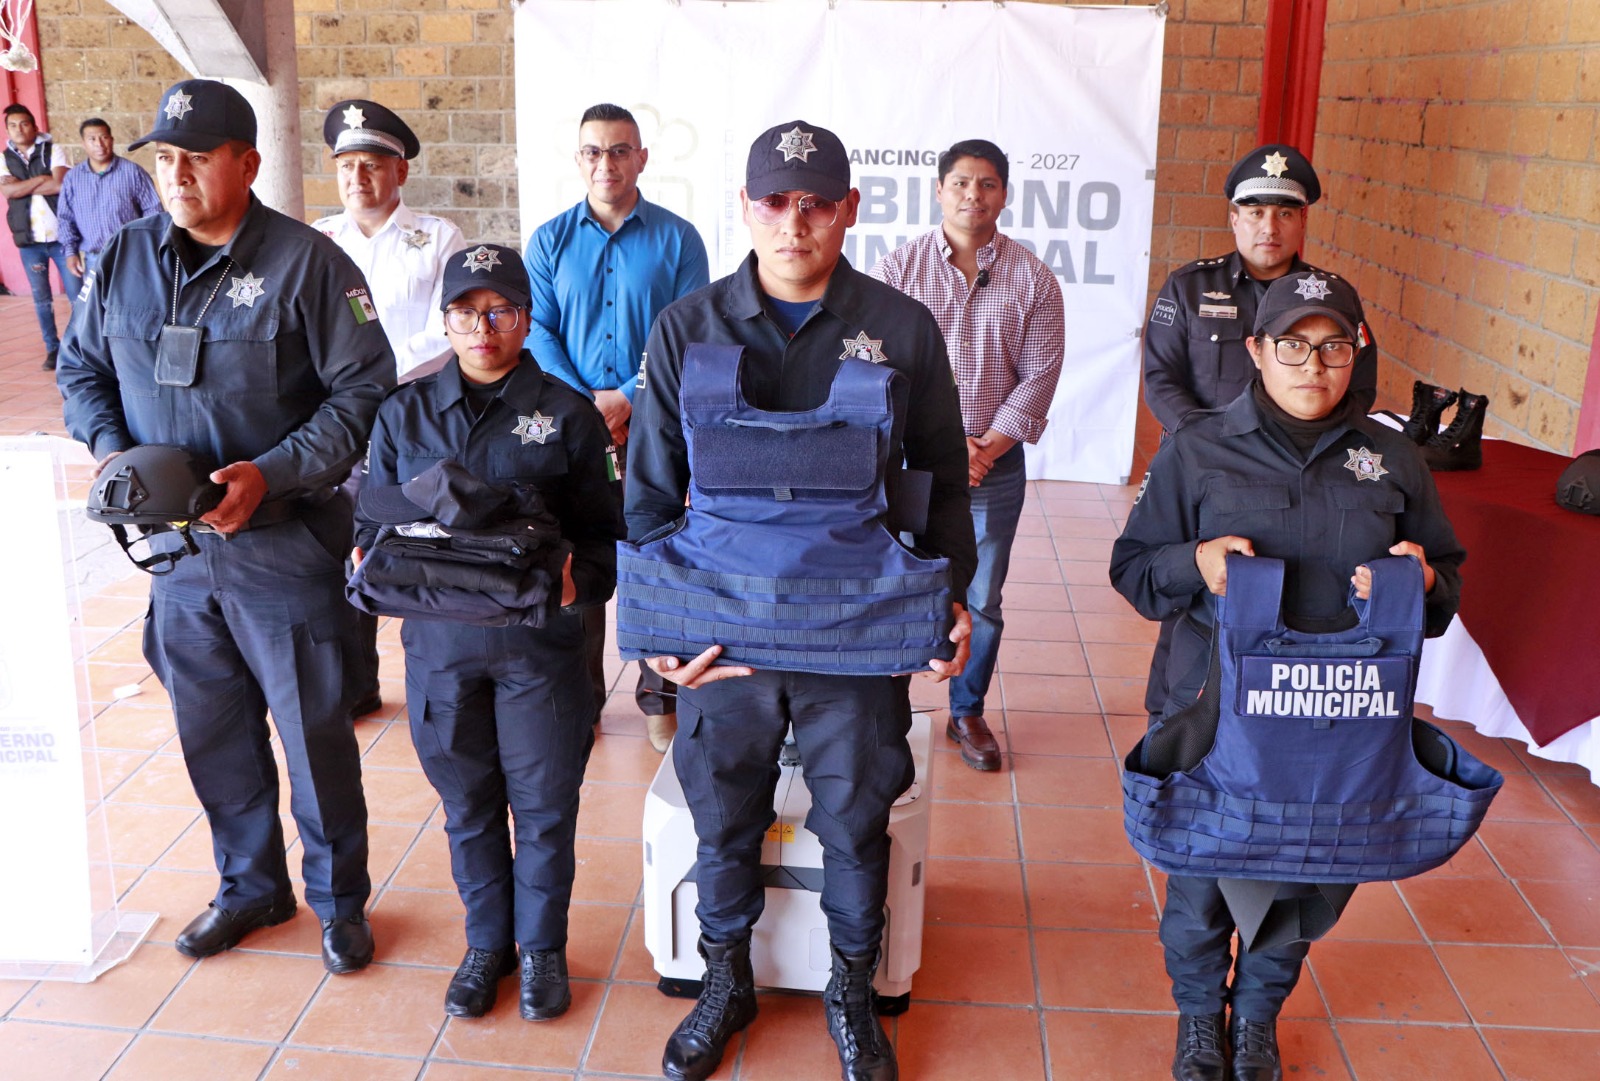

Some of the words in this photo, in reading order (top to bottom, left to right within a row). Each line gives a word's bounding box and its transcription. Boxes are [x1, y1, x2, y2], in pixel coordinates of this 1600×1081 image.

[849, 149, 945, 166] ANCING
[1030, 153, 1080, 170] 2027
[1155, 311, 1173, 320] VIAL
[1156, 304, 1174, 313] POLICÍA
[1271, 661, 1380, 691] POLICÍA
[1246, 690, 1400, 717] MUNICIPAL
